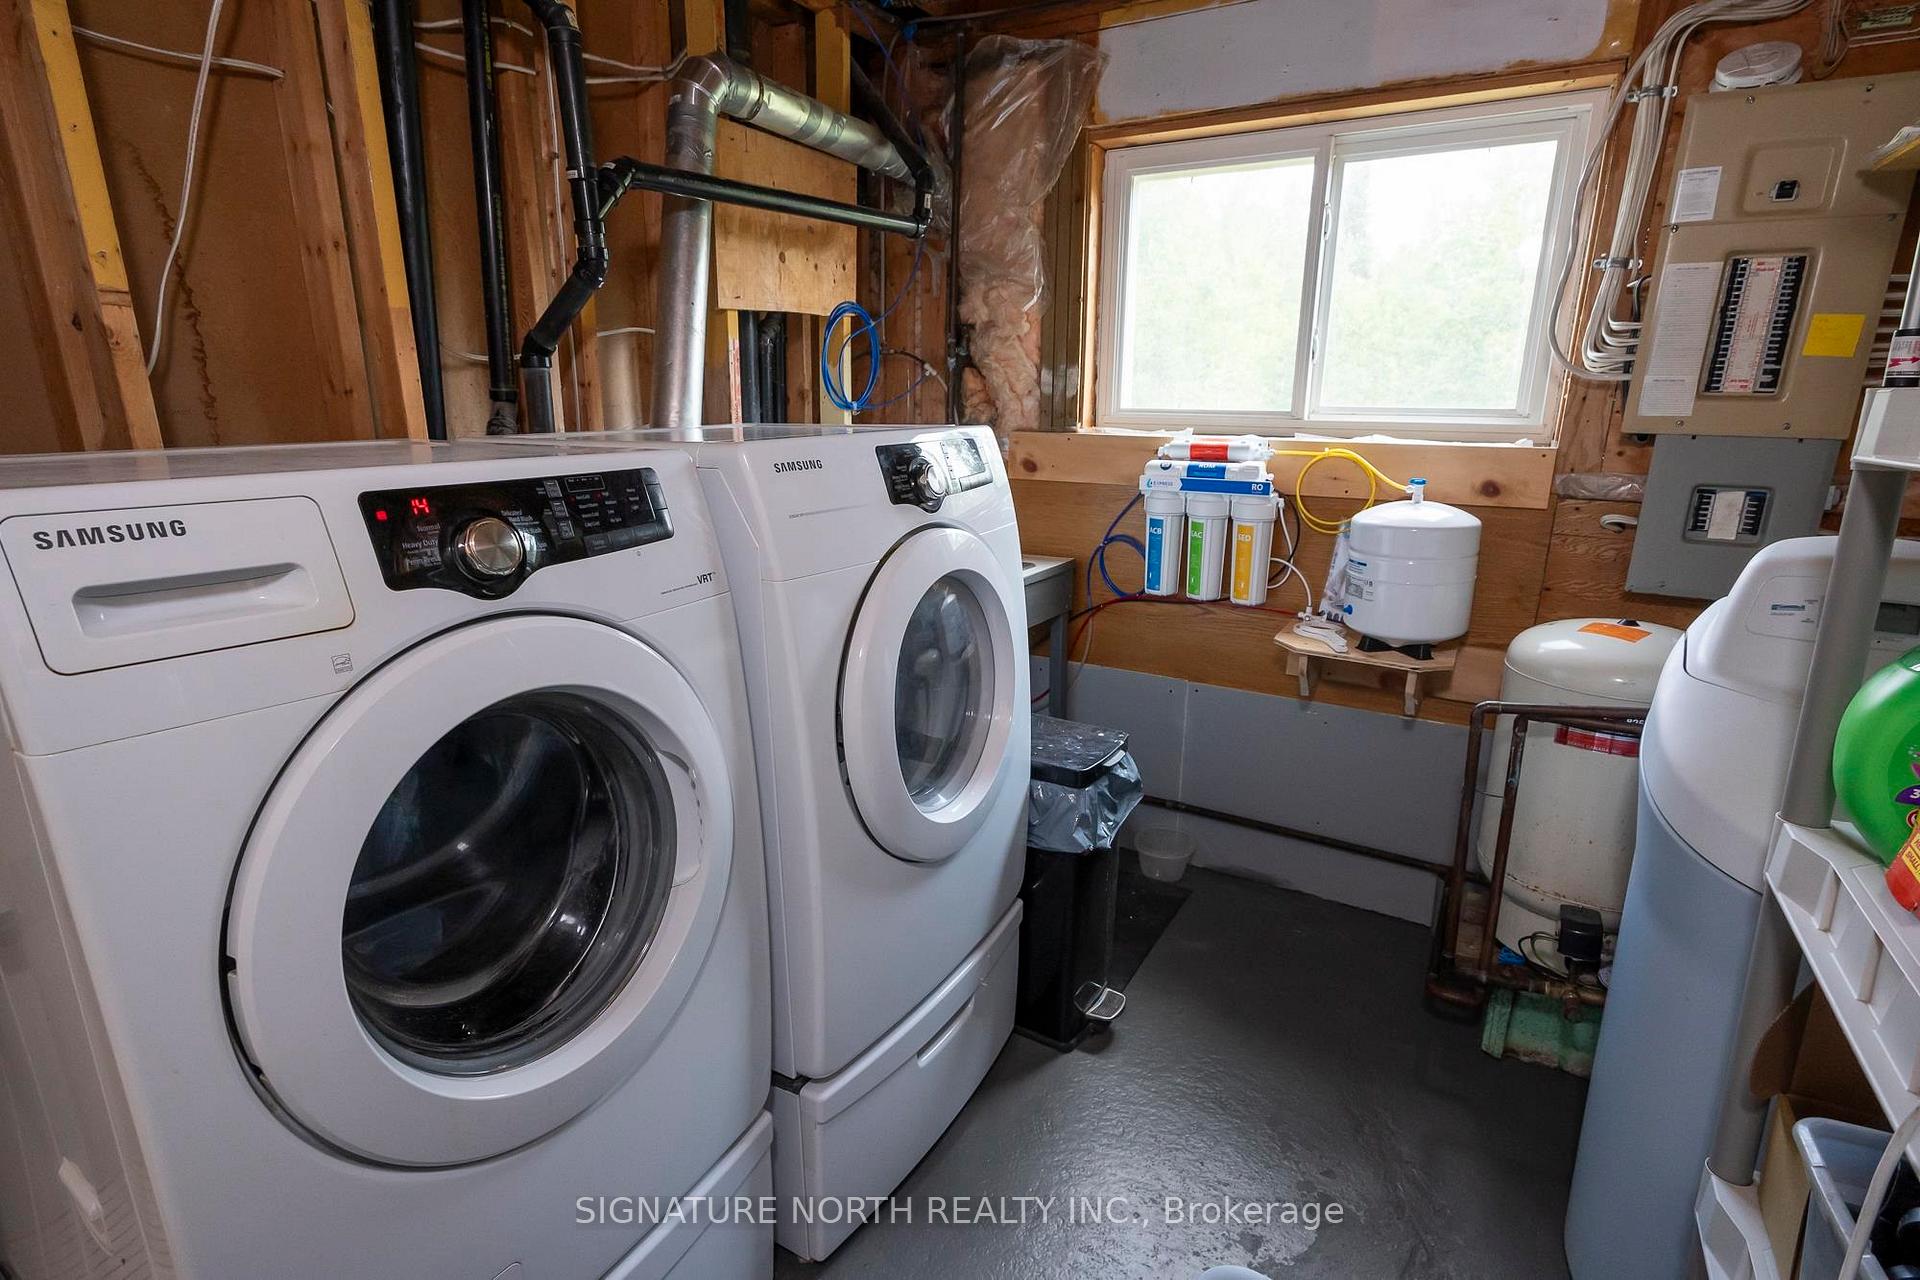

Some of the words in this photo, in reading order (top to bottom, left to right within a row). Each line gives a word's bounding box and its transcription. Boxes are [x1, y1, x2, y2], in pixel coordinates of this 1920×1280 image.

[774, 459, 823, 474] SAMSUNG
[1251, 483, 1264, 491] RO
[411, 498, 430, 515] 14
[33, 519, 187, 551] SAMSUNG
[1149, 526, 1162, 535] ACB
[1238, 533, 1251, 542] SED
[402, 540, 422, 550] Heavy
[422, 538, 439, 547] Duty
[697, 572, 713, 585] VRT
